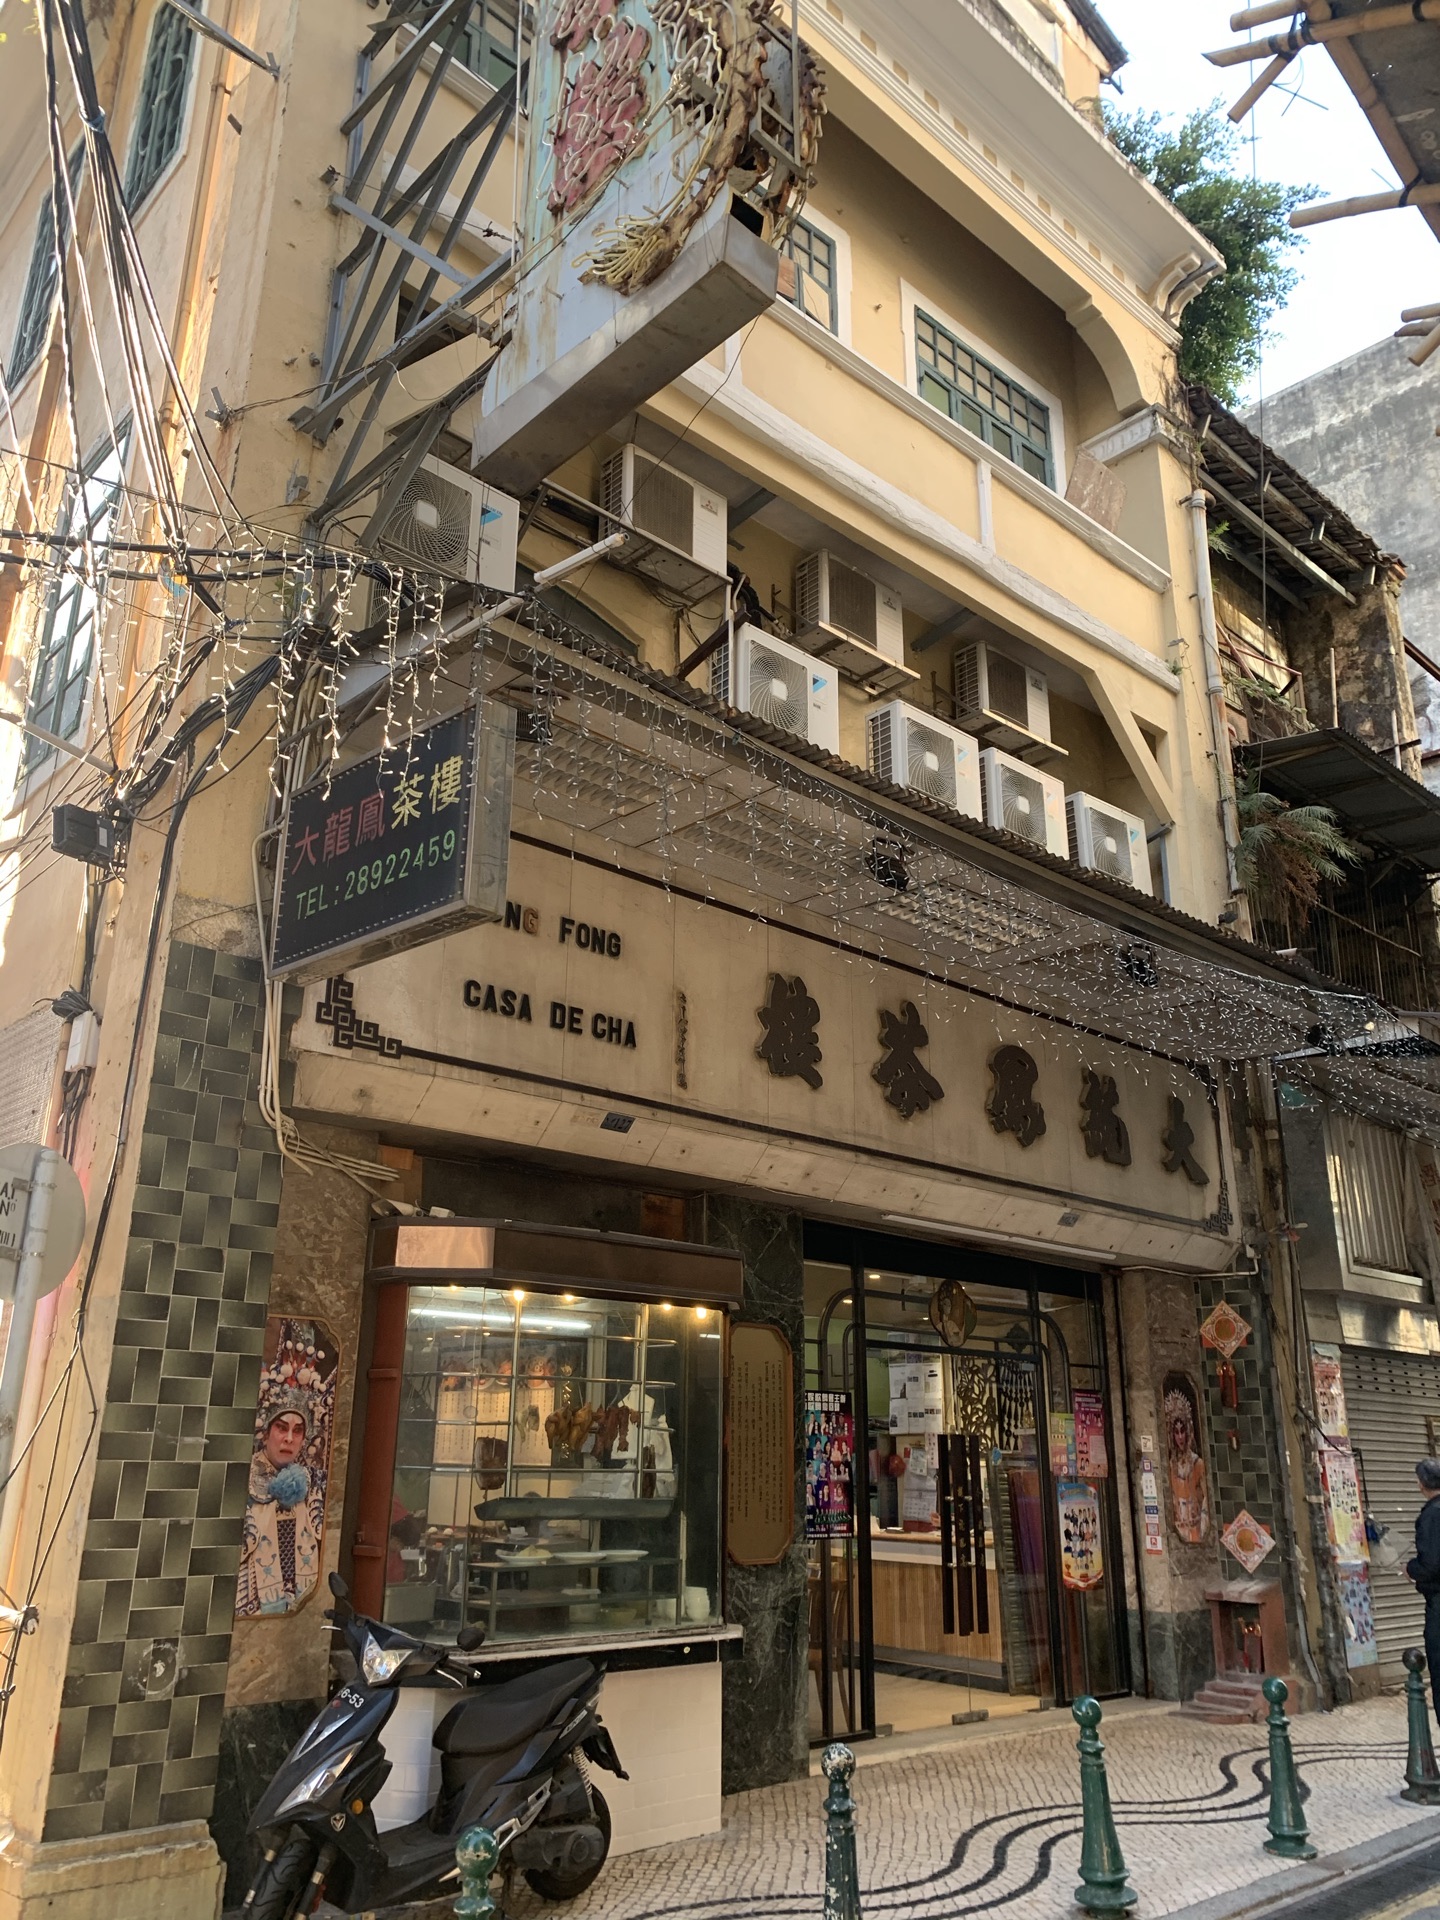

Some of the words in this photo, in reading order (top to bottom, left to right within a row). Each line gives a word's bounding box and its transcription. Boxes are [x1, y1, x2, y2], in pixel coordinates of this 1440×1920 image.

[494, 901, 541, 935] NG
[558, 916, 622, 958] FONG
[463, 979, 533, 1023] CASA
[549, 1001, 584, 1035] DE
[591, 1012, 637, 1048] CHA
